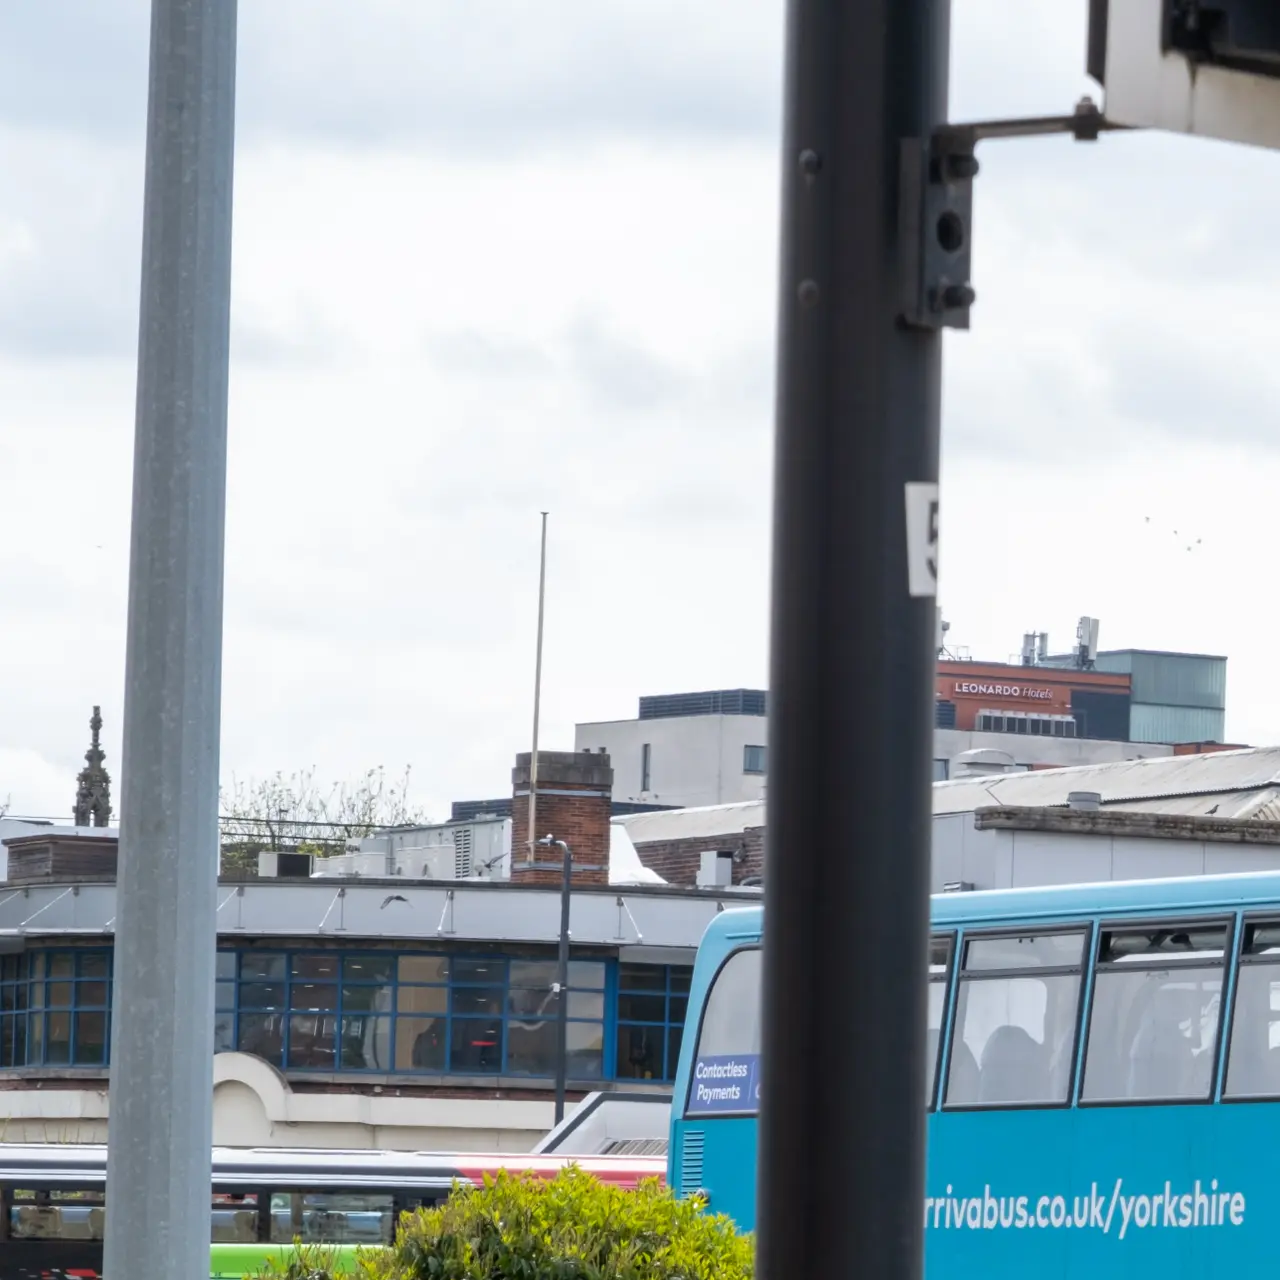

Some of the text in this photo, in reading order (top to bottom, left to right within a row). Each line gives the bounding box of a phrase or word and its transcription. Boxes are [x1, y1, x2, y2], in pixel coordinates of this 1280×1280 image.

[955, 683, 1053, 699] LEONARDO Hotels
[696, 1061, 748, 1079] Contactless
[697, 1084, 741, 1105] Payments
[924, 1178, 1245, 1240] rrivabus.co.uk/yorkshire
